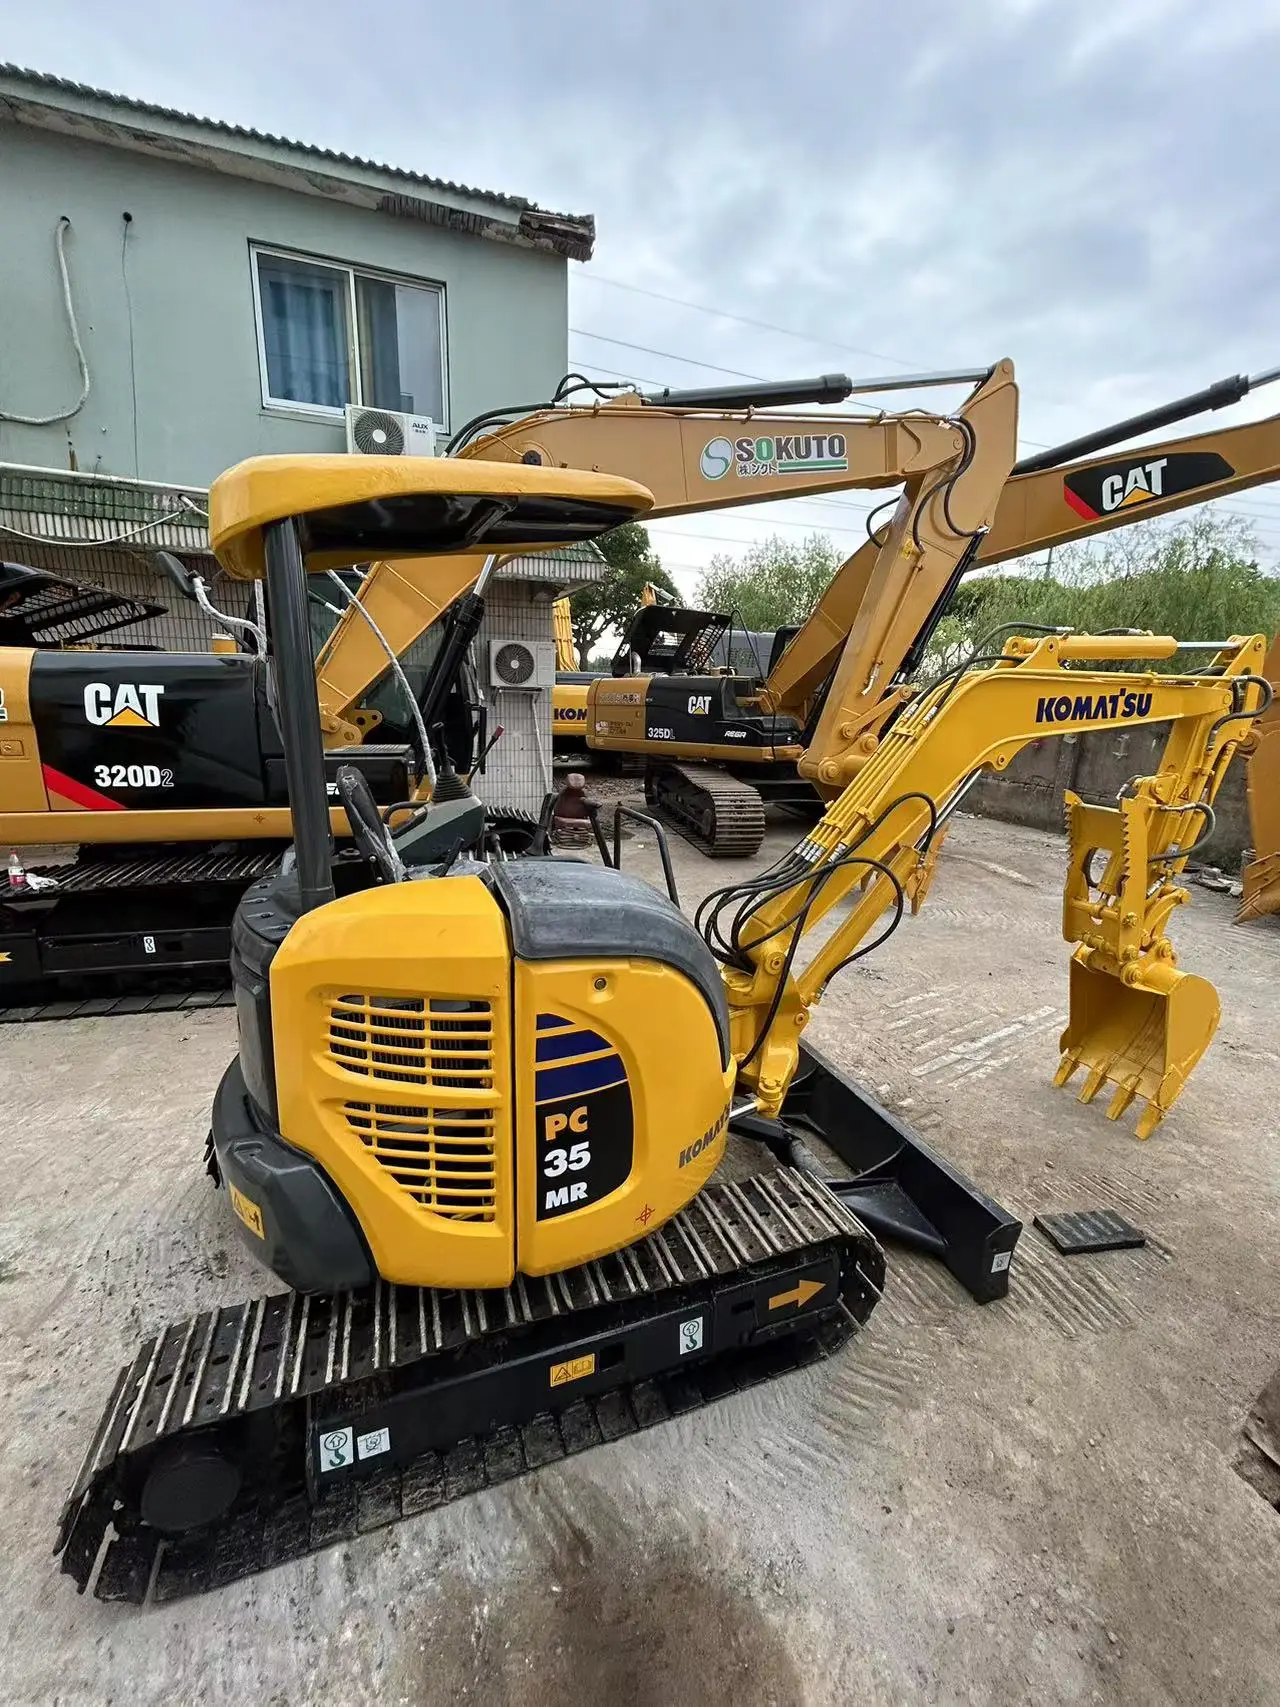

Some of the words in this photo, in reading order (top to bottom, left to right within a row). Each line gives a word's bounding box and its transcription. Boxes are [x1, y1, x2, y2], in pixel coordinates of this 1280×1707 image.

[412, 422, 428, 430] AUX
[735, 434, 845, 462] SOKUTO
[1102, 458, 1168, 511] CAT
[84, 682, 165, 727] CAT
[687, 695, 712, 715] CAT
[1035, 687, 1153, 723] KOMATSU
[94, 764, 175, 788] 320D2
[545, 1105, 588, 1141] PC
[543, 1141, 591, 1178] 35
[545, 1181, 588, 1210] MR
